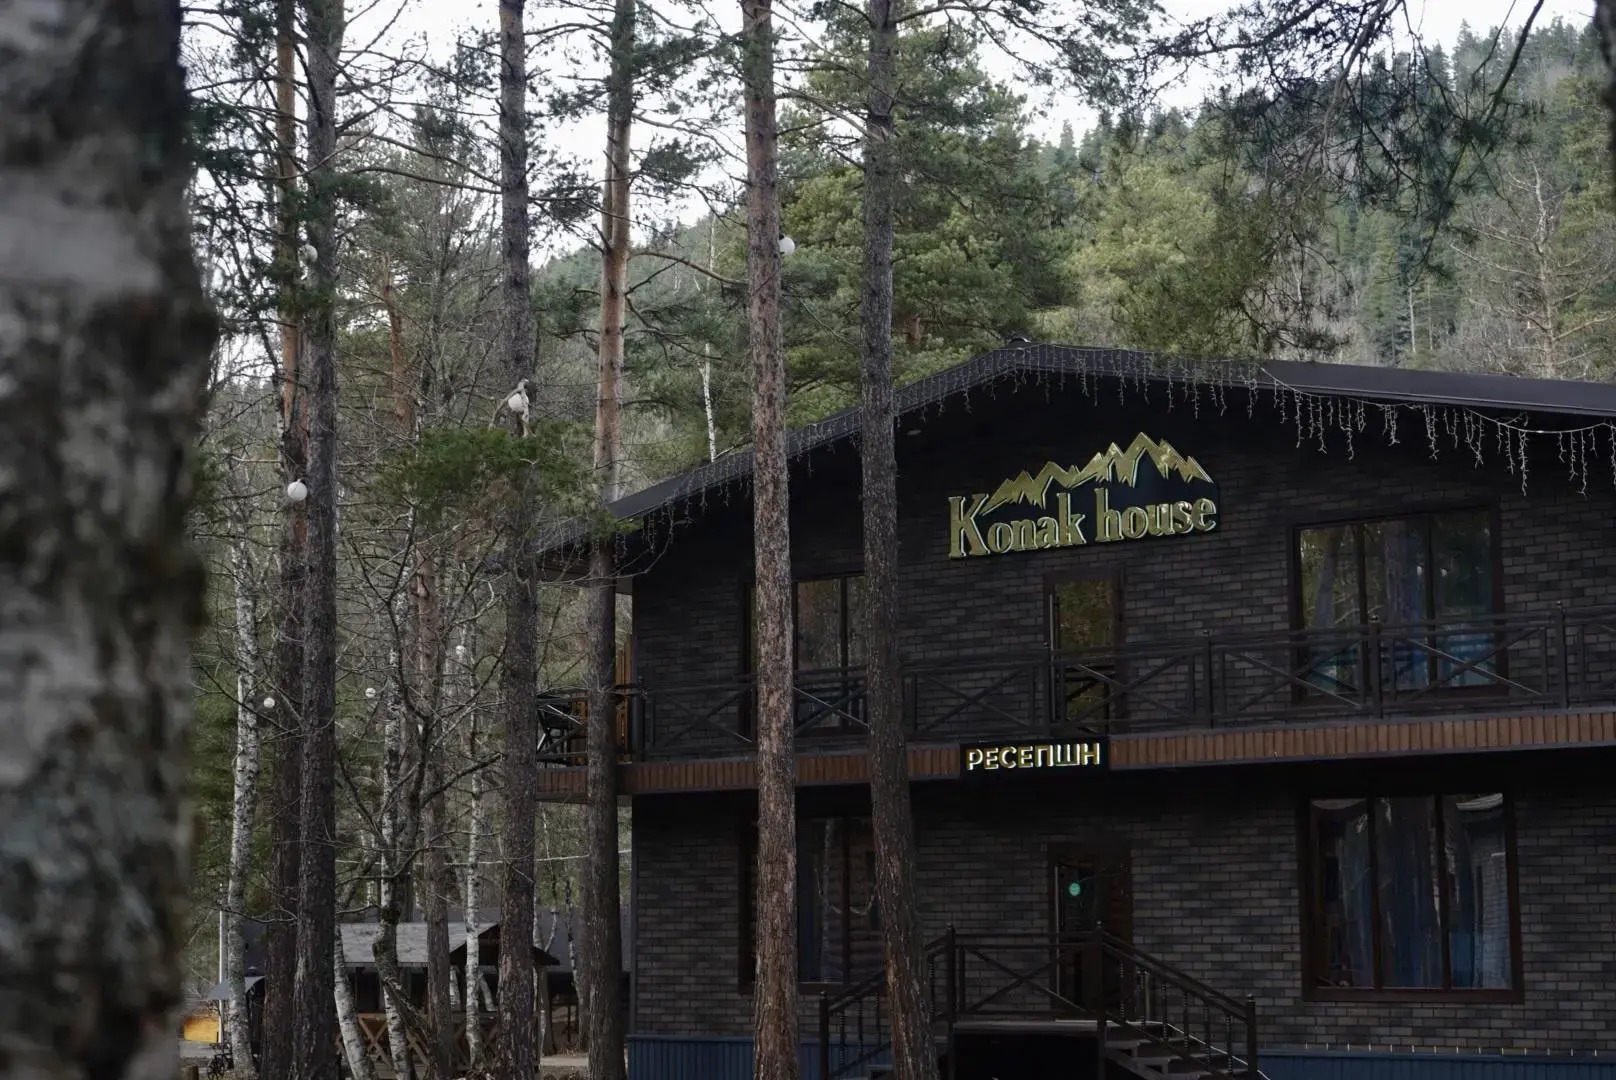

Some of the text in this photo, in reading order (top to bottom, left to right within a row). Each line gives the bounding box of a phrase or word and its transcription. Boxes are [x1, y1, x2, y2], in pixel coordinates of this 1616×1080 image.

[948, 487, 1217, 559] Konak house
[966, 742, 1101, 771] РЕСЕПШН
